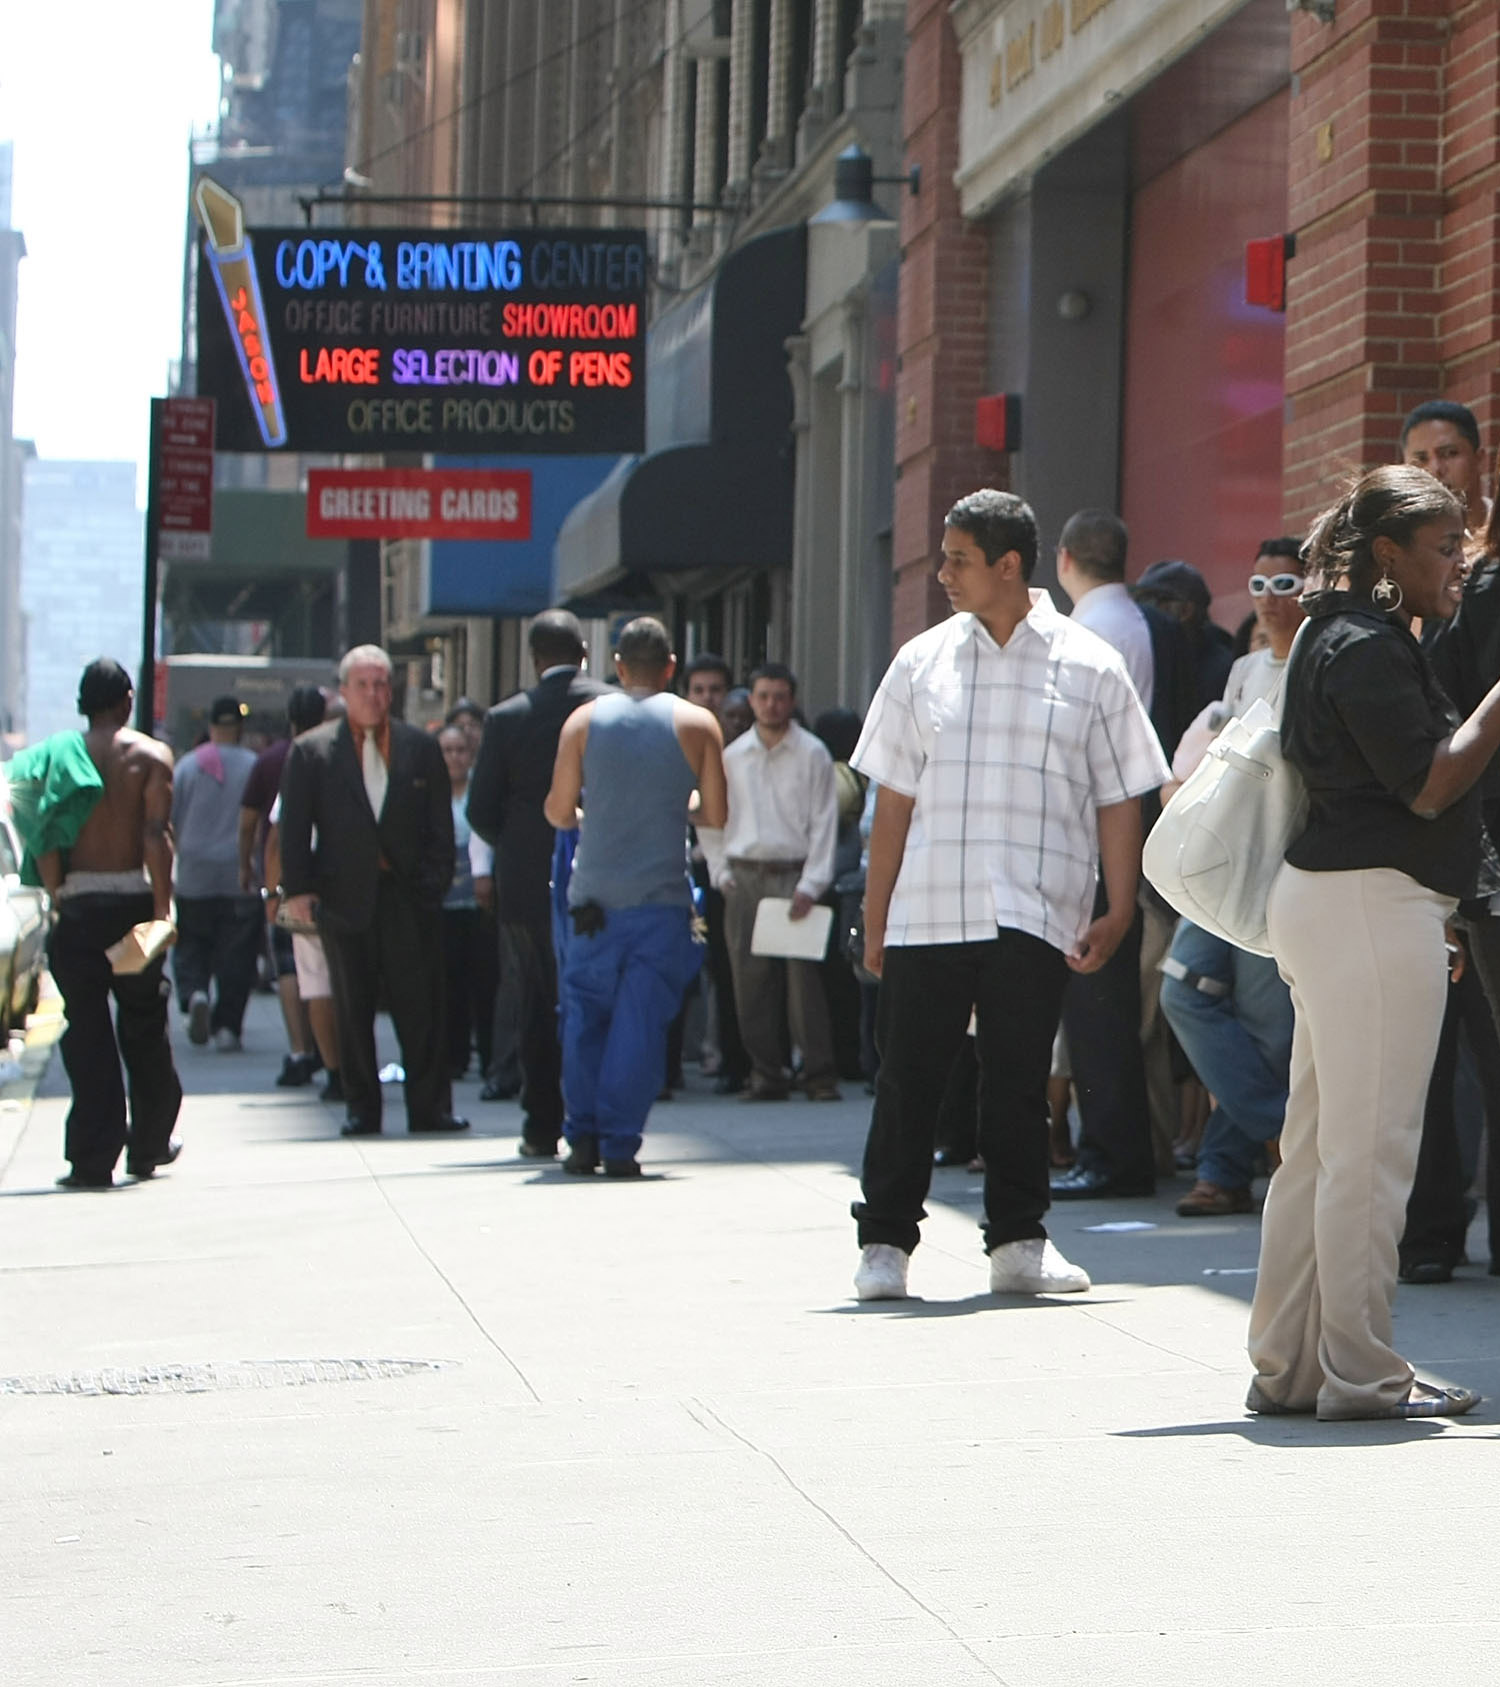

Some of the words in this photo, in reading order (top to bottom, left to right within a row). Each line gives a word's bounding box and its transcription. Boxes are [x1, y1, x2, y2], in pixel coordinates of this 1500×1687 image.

[276, 239, 353, 290] COPY
[364, 240, 387, 291] &
[531, 241, 643, 290] CENTER
[285, 301, 362, 333] OFFICE
[371, 302, 491, 335] FURNITURE
[502, 303, 637, 339] SHOWROOM
[300, 348, 380, 384] LARGE
[393, 349, 519, 386] SELECTION
[528, 350, 563, 385] OF
[570, 351, 632, 387] PENS
[348, 399, 432, 433] OFFICE
[442, 400, 575, 434] PRODUCTS
[320, 486, 430, 521] GREETING
[440, 488, 518, 521] CARDS
